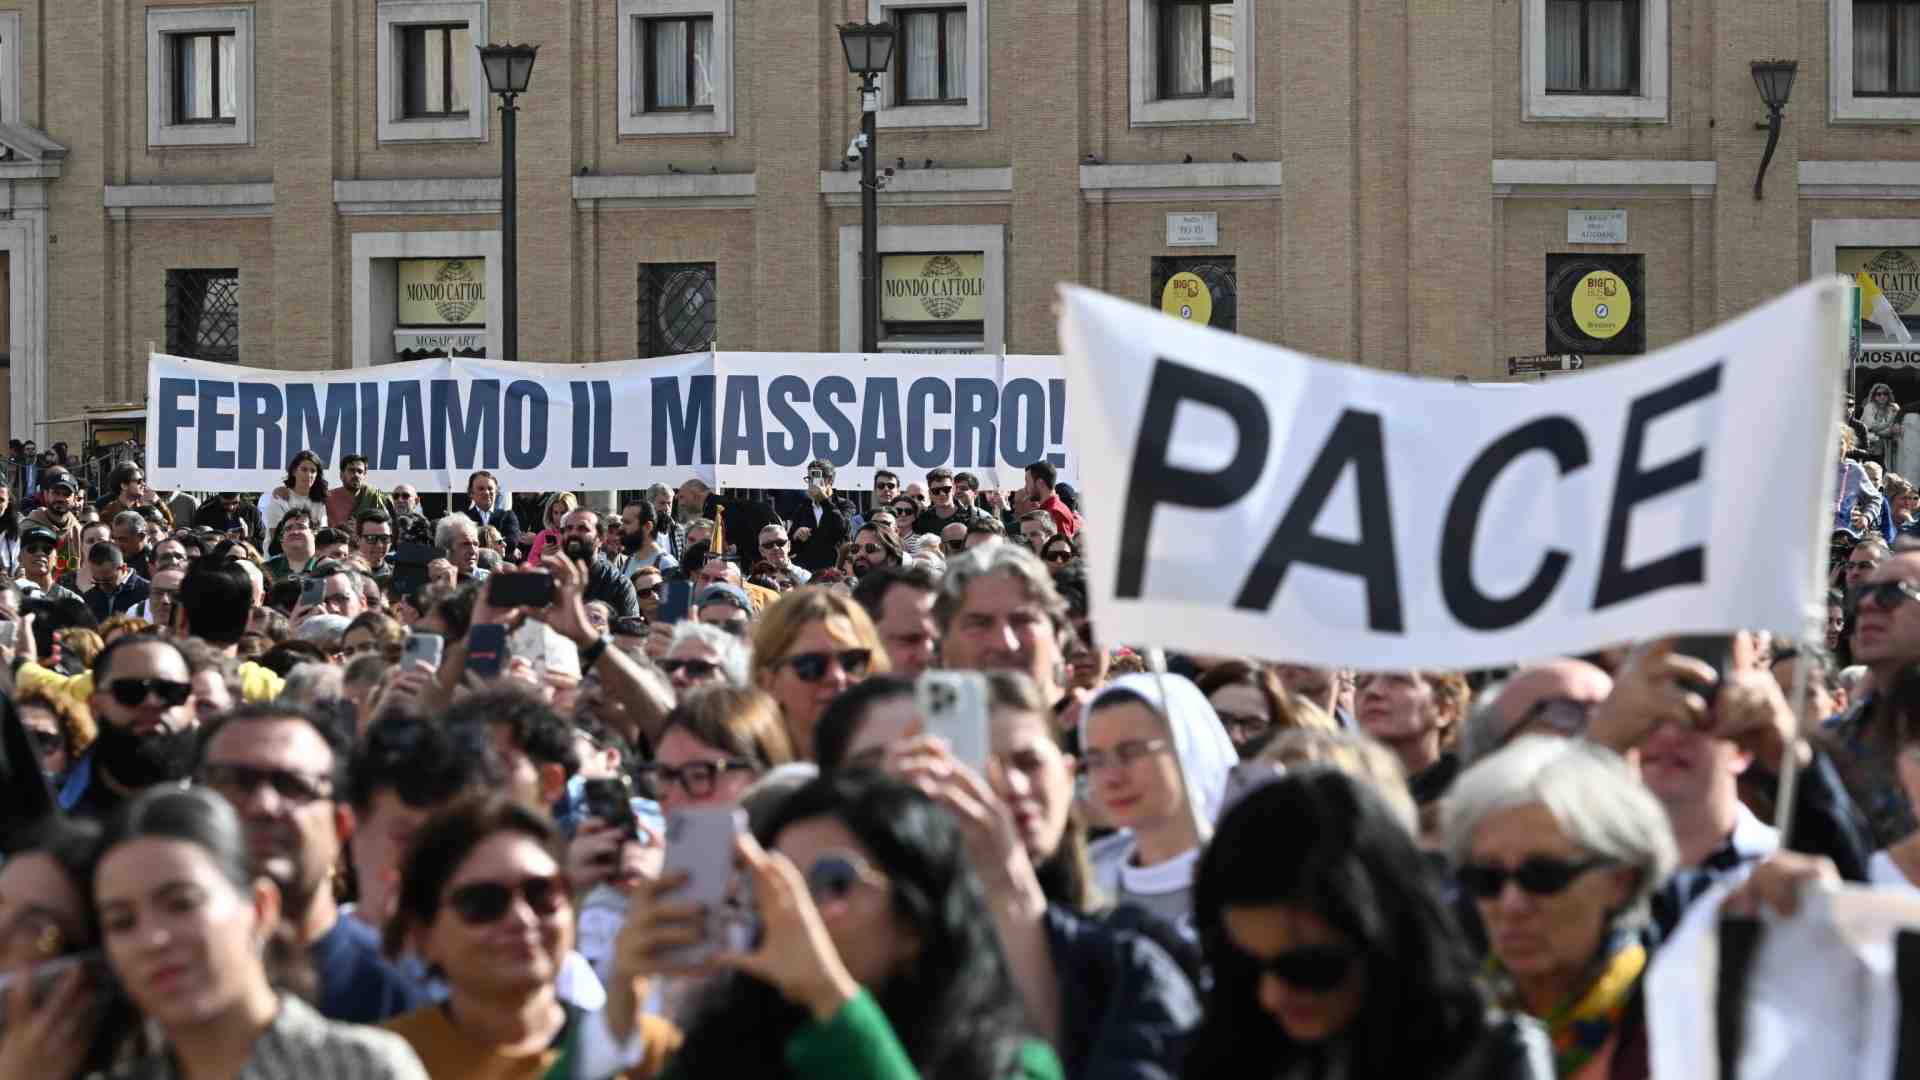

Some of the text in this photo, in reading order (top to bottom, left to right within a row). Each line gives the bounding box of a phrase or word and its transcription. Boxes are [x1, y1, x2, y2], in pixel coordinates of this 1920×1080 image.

[407, 282, 444, 302] MONDO
[885, 279, 929, 298] MONDO
[1587, 278, 1604, 288] BIG
[157, 374, 1066, 471] FERMIAMO IL MASSACRO!
[1113, 356, 1727, 637] PACE
